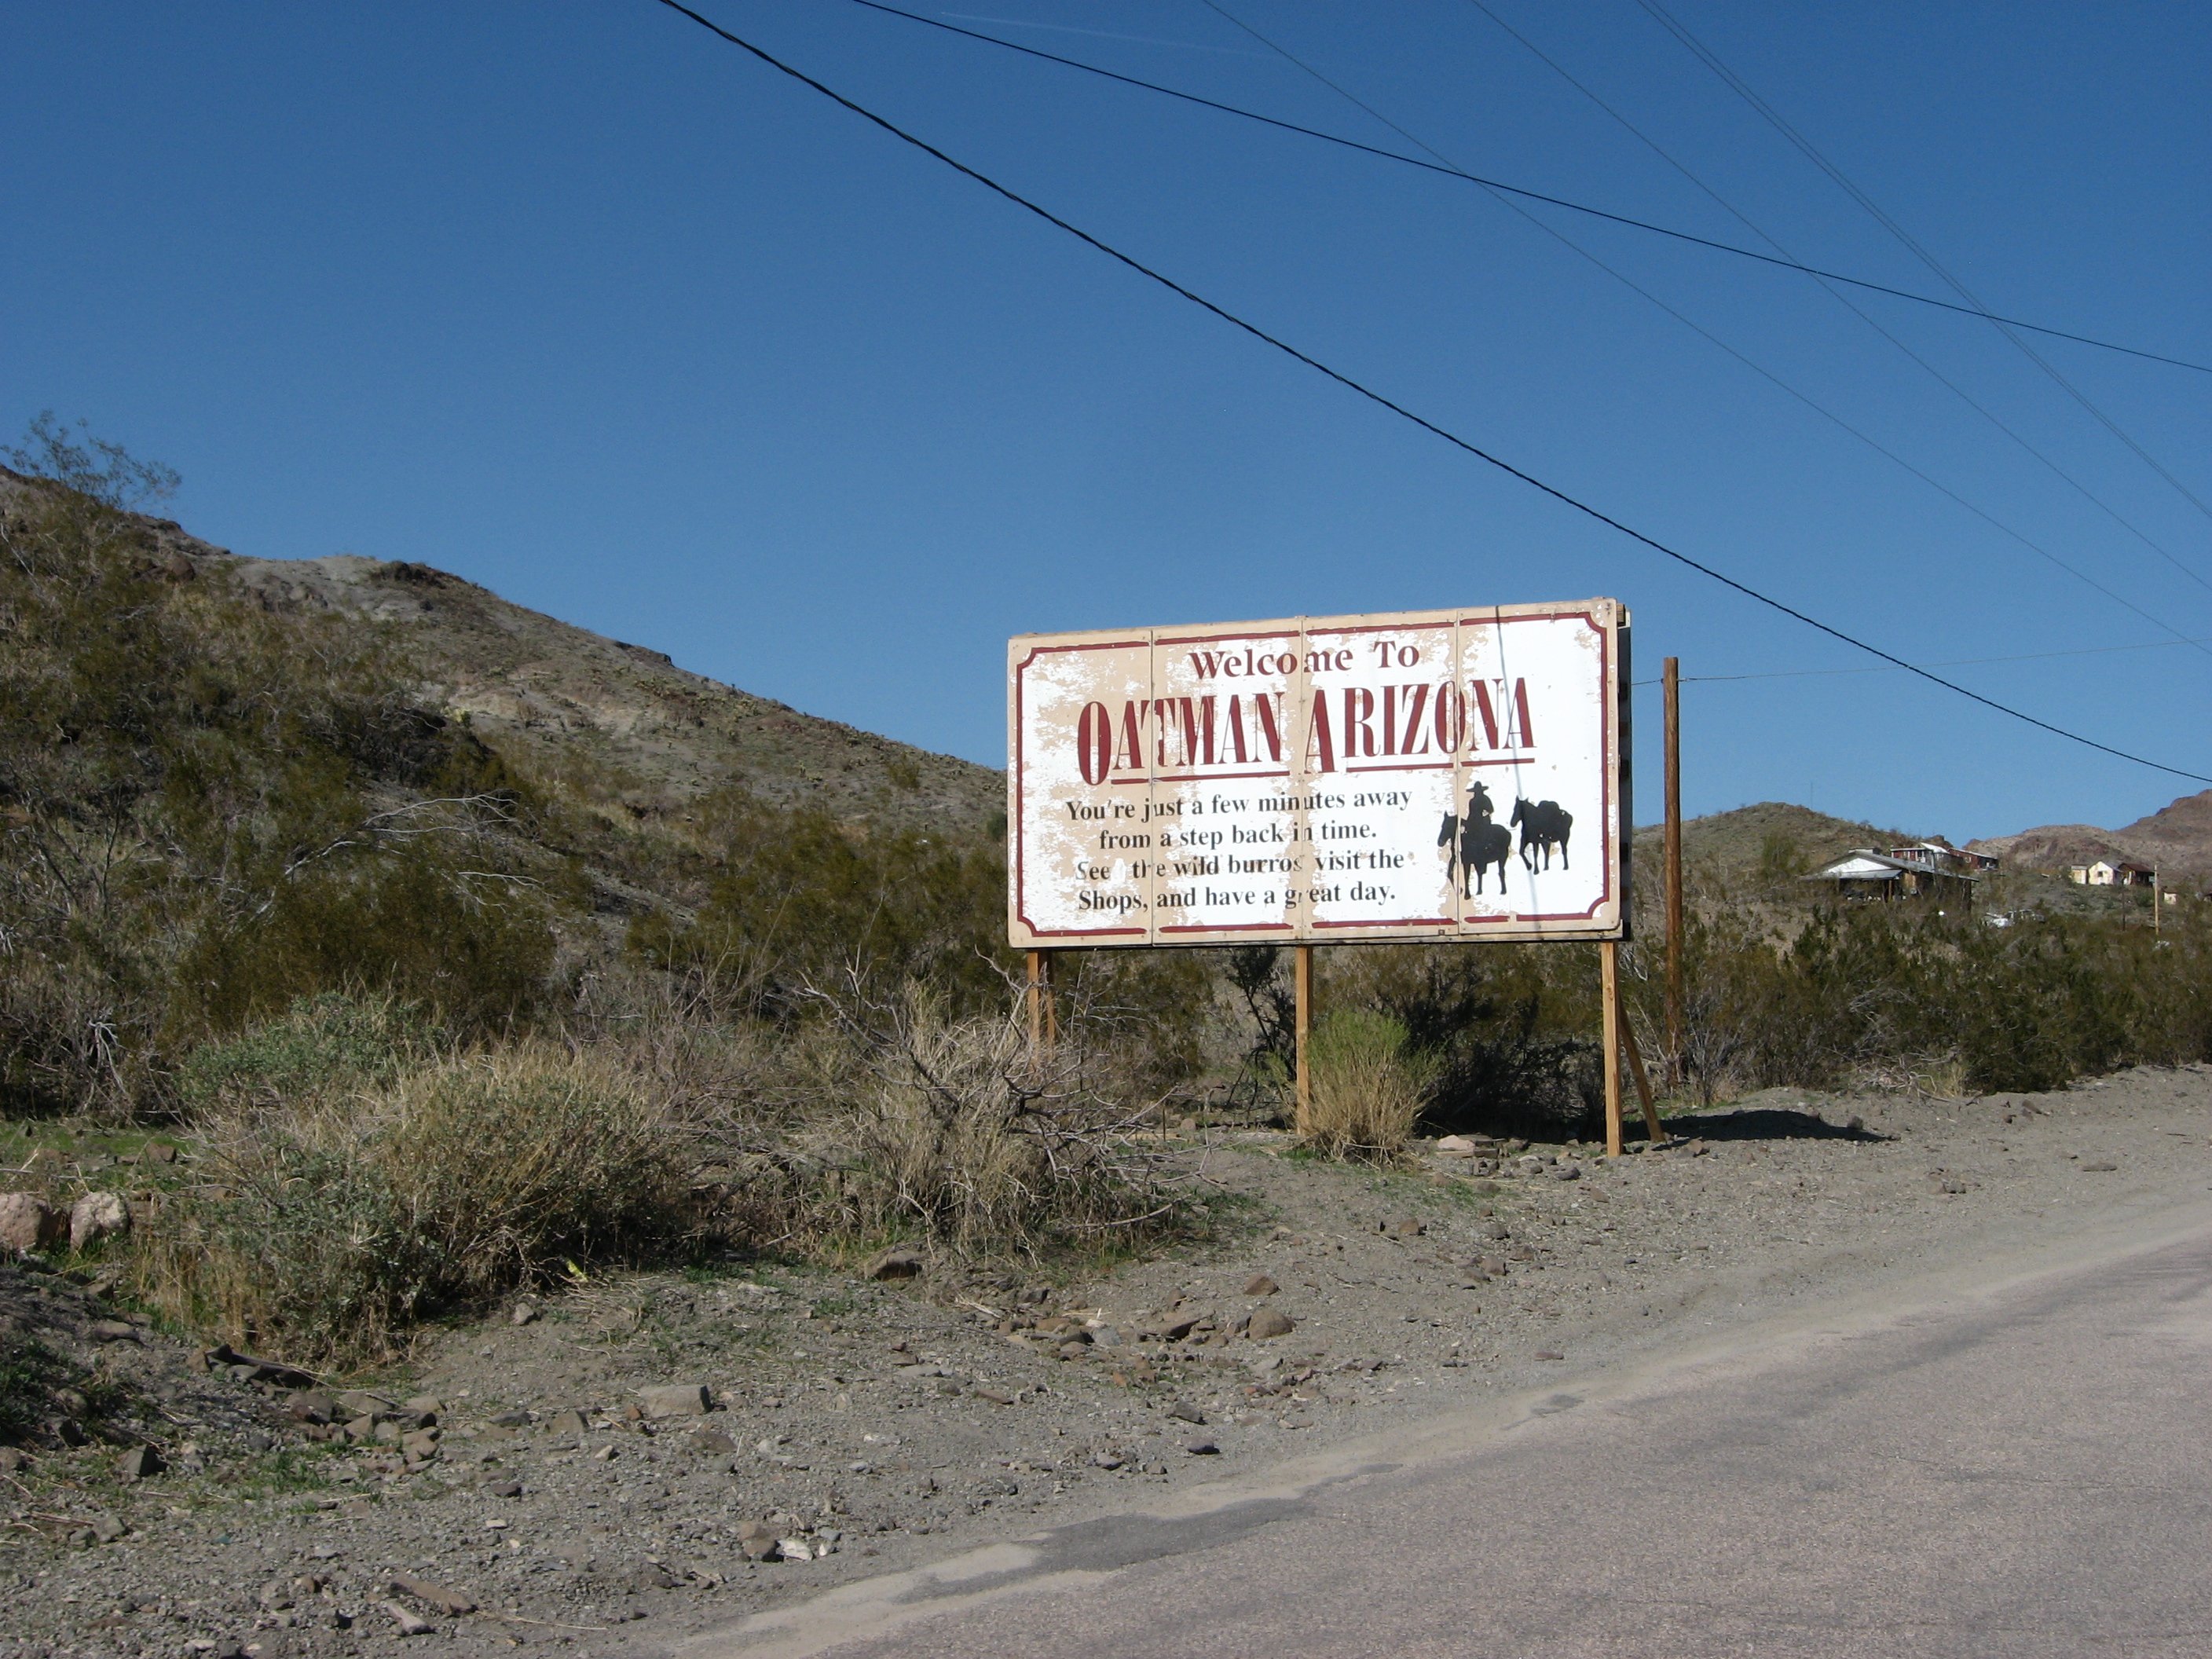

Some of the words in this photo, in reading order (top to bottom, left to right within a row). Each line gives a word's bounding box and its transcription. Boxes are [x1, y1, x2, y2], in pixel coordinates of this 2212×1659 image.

[1188, 648, 1353, 680] Welcome
[1373, 639, 1420, 669] To
[1077, 691, 1285, 786] OATMAN
[1303, 676, 1537, 775] ARIZONA
[1066, 799, 1136, 821] You're
[1141, 797, 1183, 823] just
[1192, 800, 1203, 815] a
[1211, 793, 1250, 814] few
[1258, 791, 1346, 812] minutes
[1353, 790, 1413, 811] away
[1099, 830, 1151, 850] from
[1159, 832, 1172, 847] a
[1179, 826, 1223, 850] step
[1232, 822, 1284, 844] back
[1292, 822, 1313, 842] in
[1321, 819, 1377, 840] time.
[1075, 860, 1111, 881] See
[1173, 855, 1219, 877] wild
[1228, 854, 1304, 875] burros
[1315, 849, 1361, 872] visit
[1368, 848, 1404, 869] the
[1079, 889, 1148, 914] Shops,
[1156, 886, 1196, 908] and
[1205, 886, 1256, 906] have
[1263, 888, 1276, 905] a
[1350, 881, 1396, 906] day.
